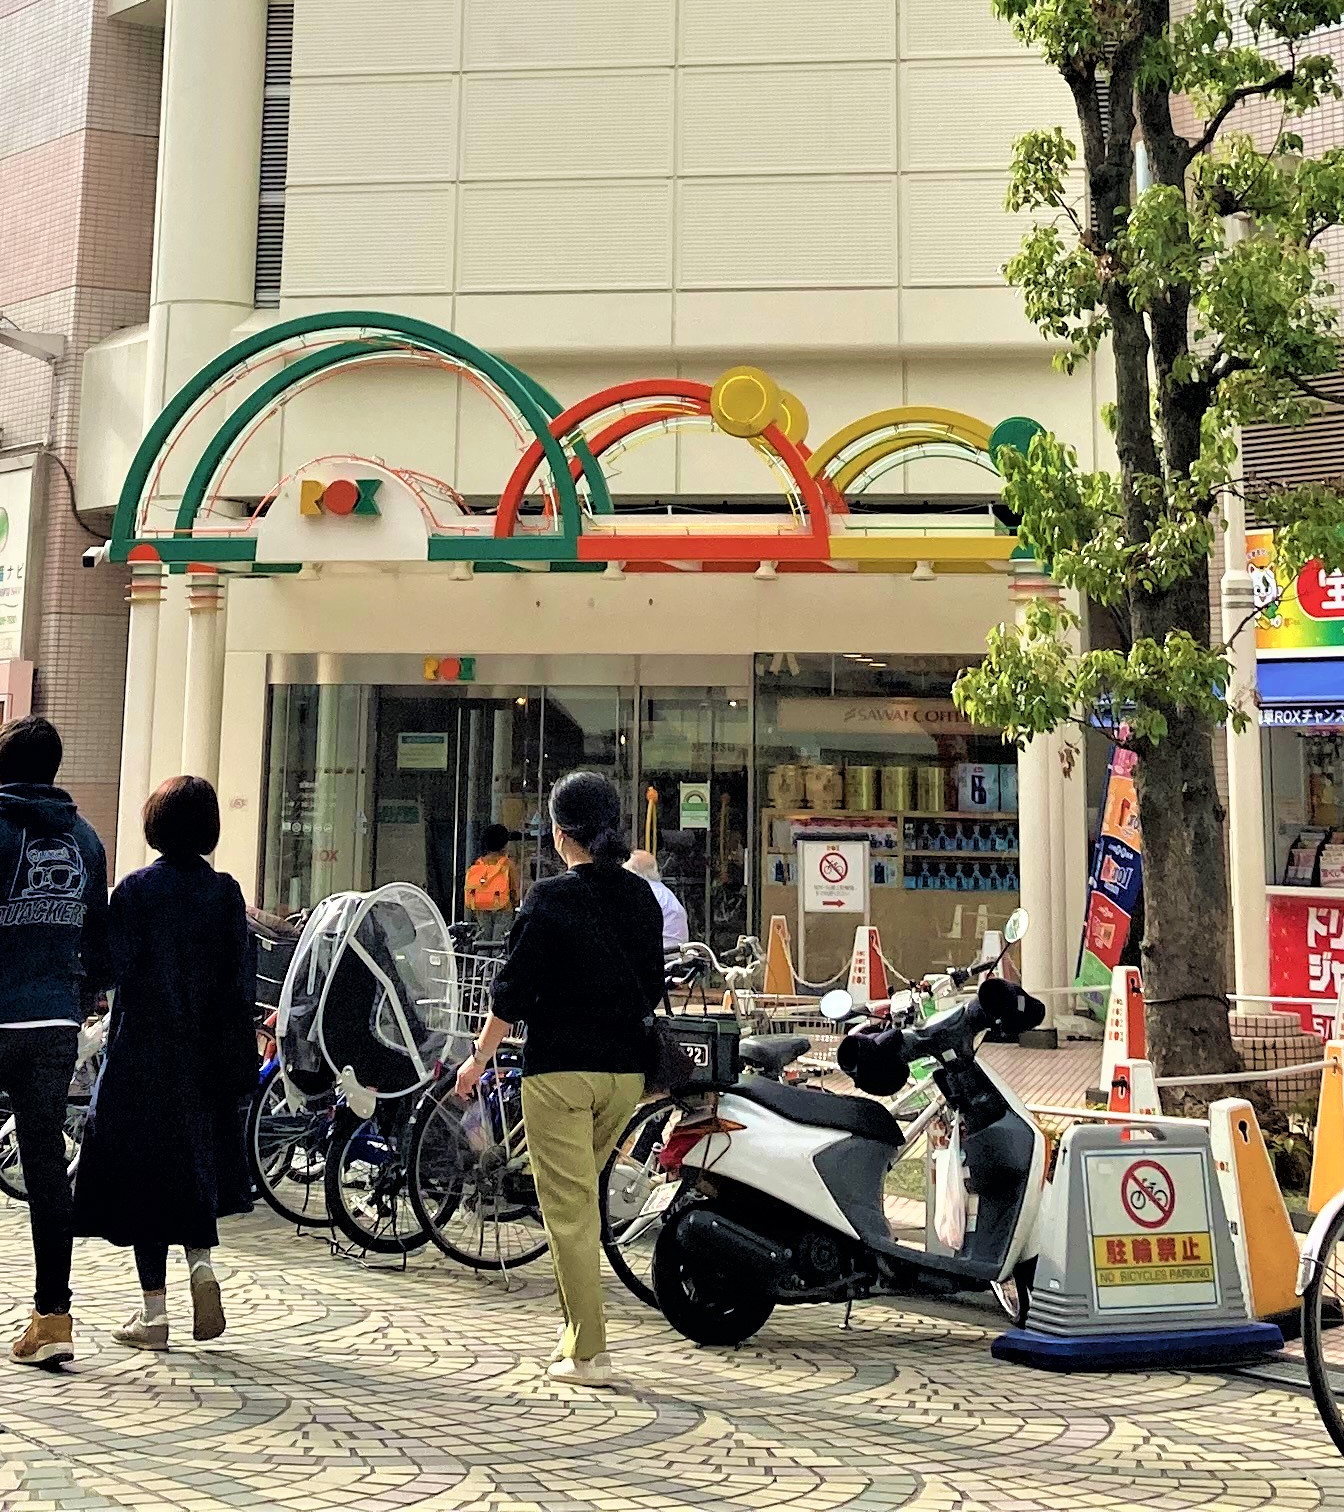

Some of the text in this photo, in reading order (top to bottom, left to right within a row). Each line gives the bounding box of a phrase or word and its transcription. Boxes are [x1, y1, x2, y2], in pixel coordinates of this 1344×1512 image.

[299, 478, 383, 518] ROX
[1106, 1236, 1201, 1265] 駐輪禁止
[1100, 1268, 1210, 1282] NO BICYCLES PARKING
